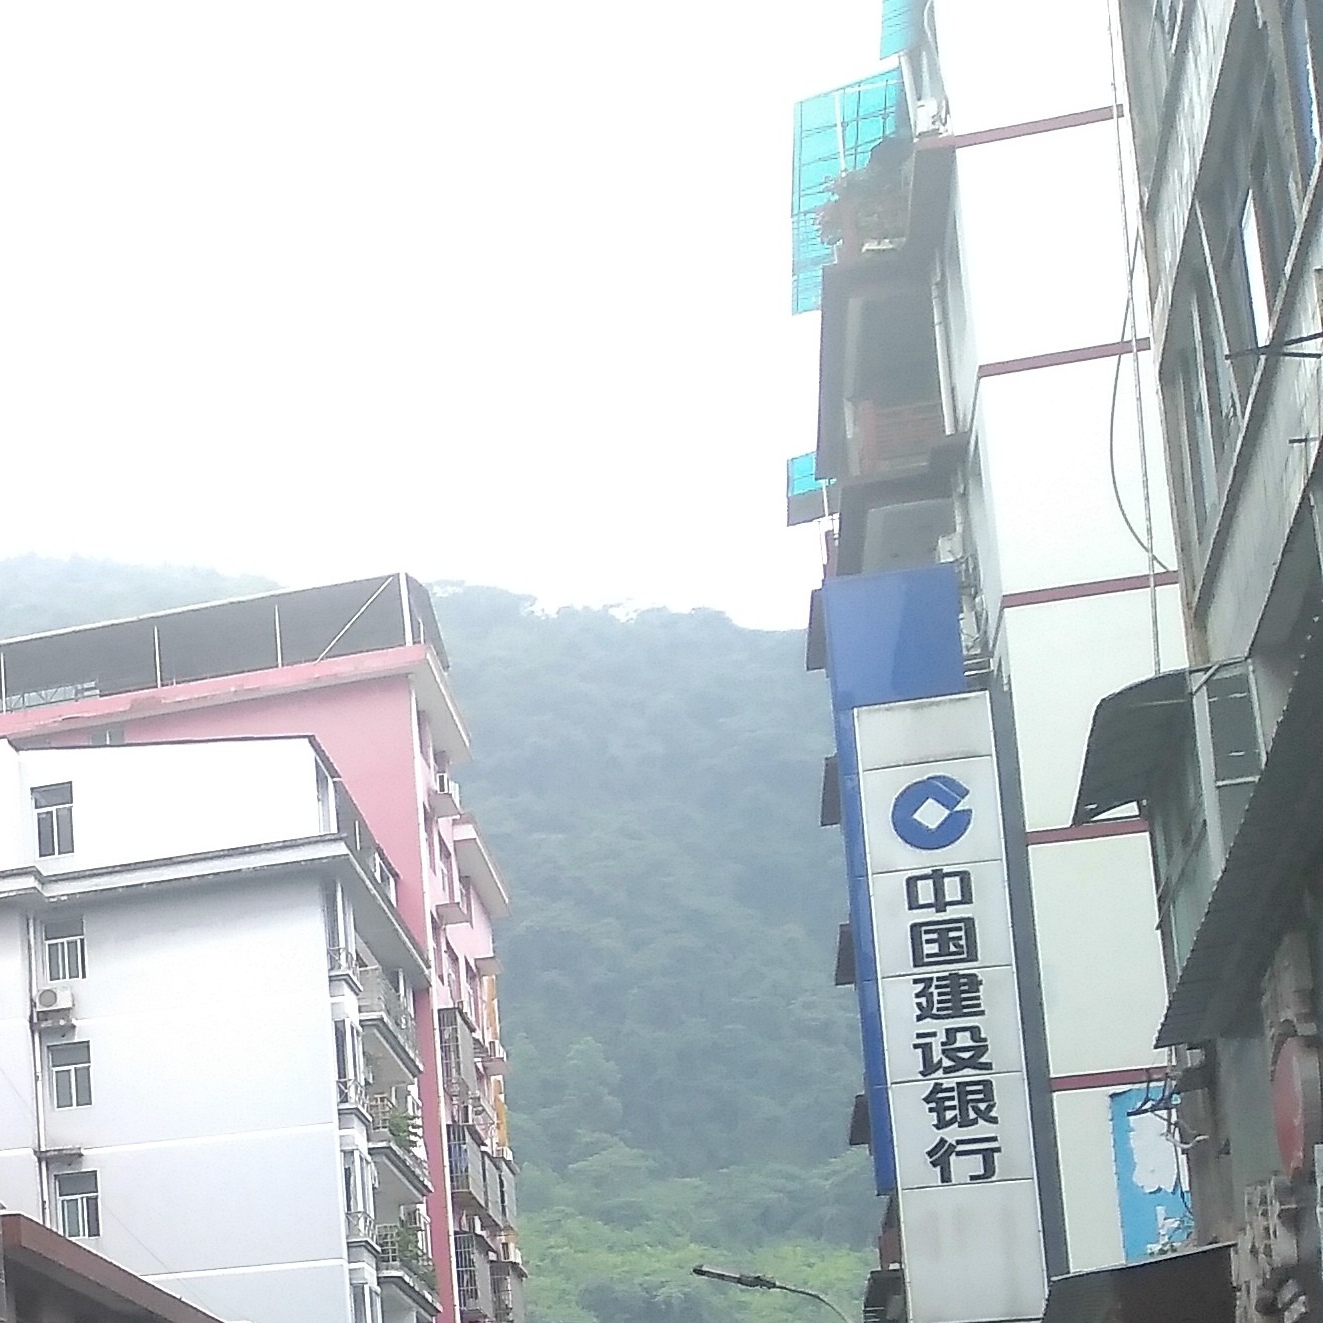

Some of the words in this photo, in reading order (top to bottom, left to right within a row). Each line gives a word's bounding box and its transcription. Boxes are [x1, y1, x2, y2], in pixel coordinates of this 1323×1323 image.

[904, 867, 1002, 1184] 中国建设银行
